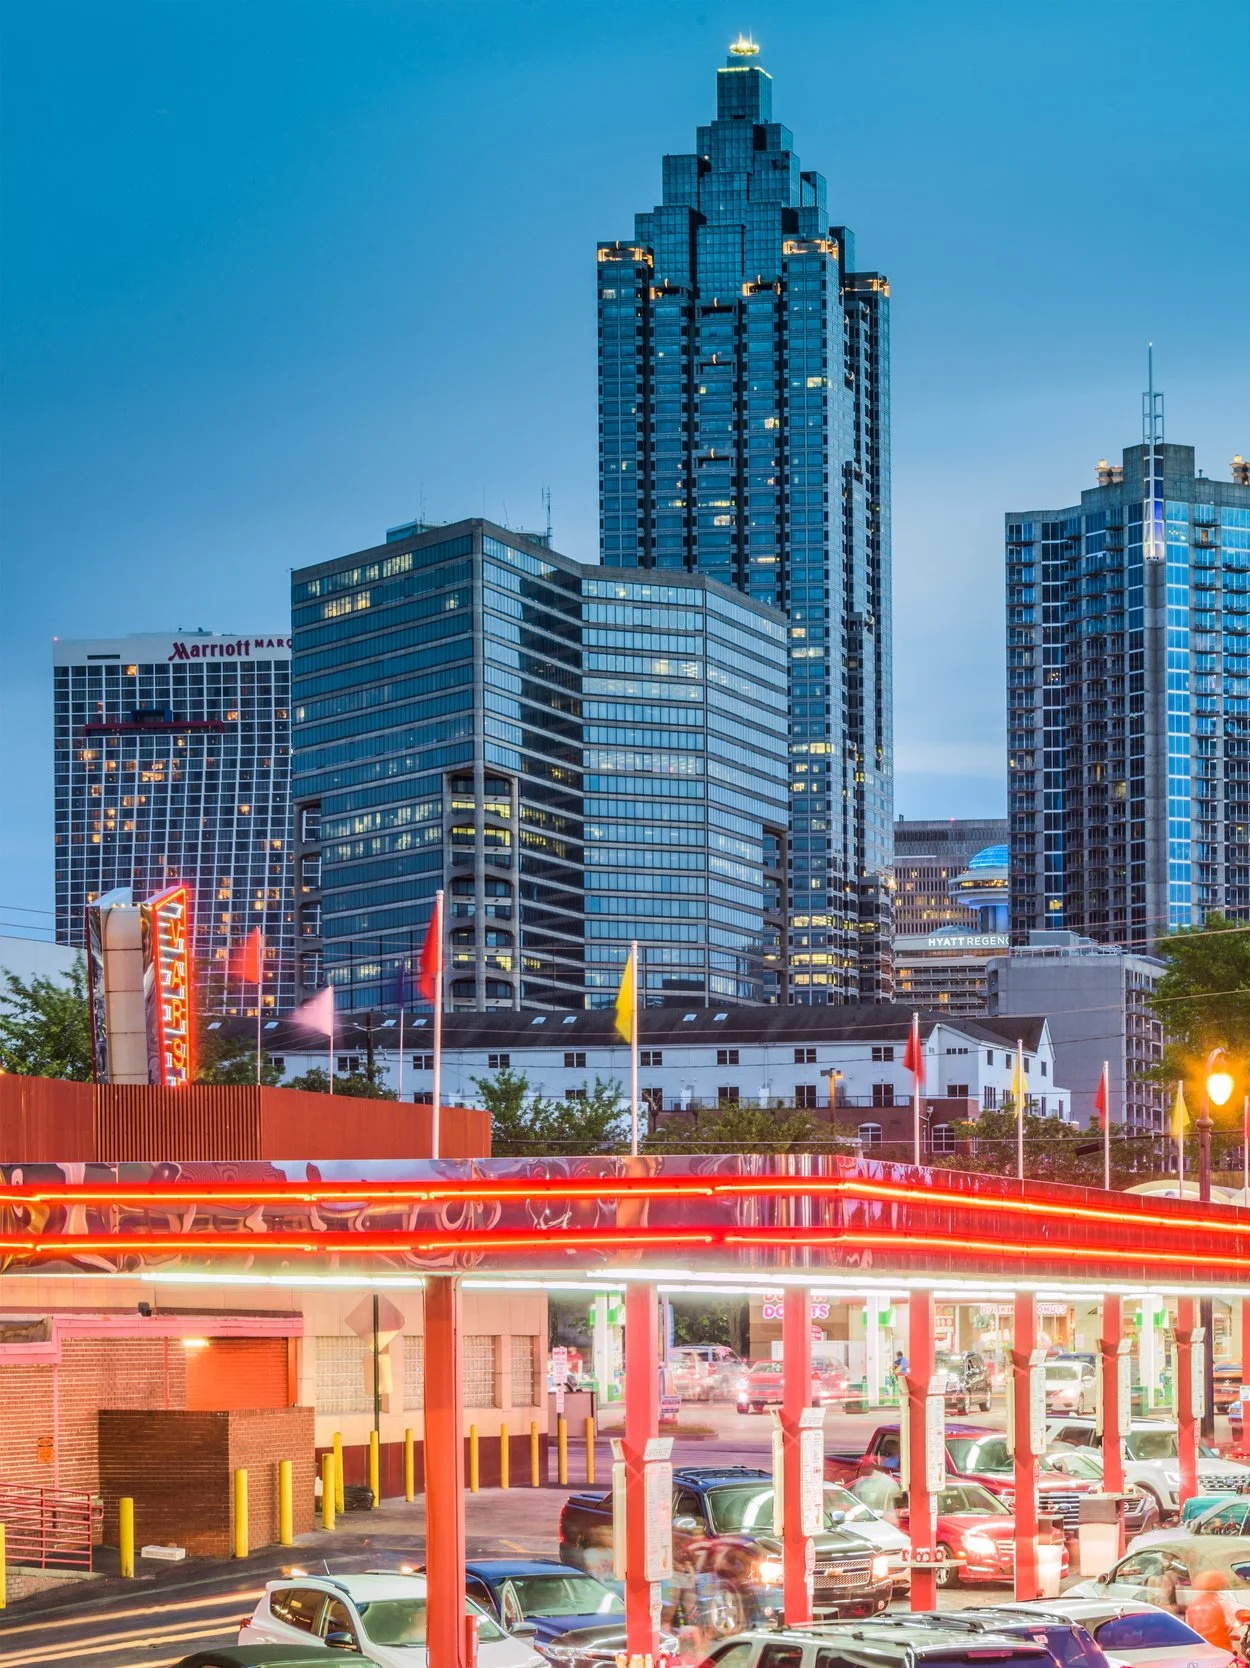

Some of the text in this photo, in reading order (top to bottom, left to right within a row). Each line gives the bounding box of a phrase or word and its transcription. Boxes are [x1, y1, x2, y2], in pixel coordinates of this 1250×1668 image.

[168, 639, 250, 661] Marriott
[928, 937, 965, 946] HYATT
[169, 918, 185, 1087] VARS
[763, 1304, 829, 1319] DOTS
